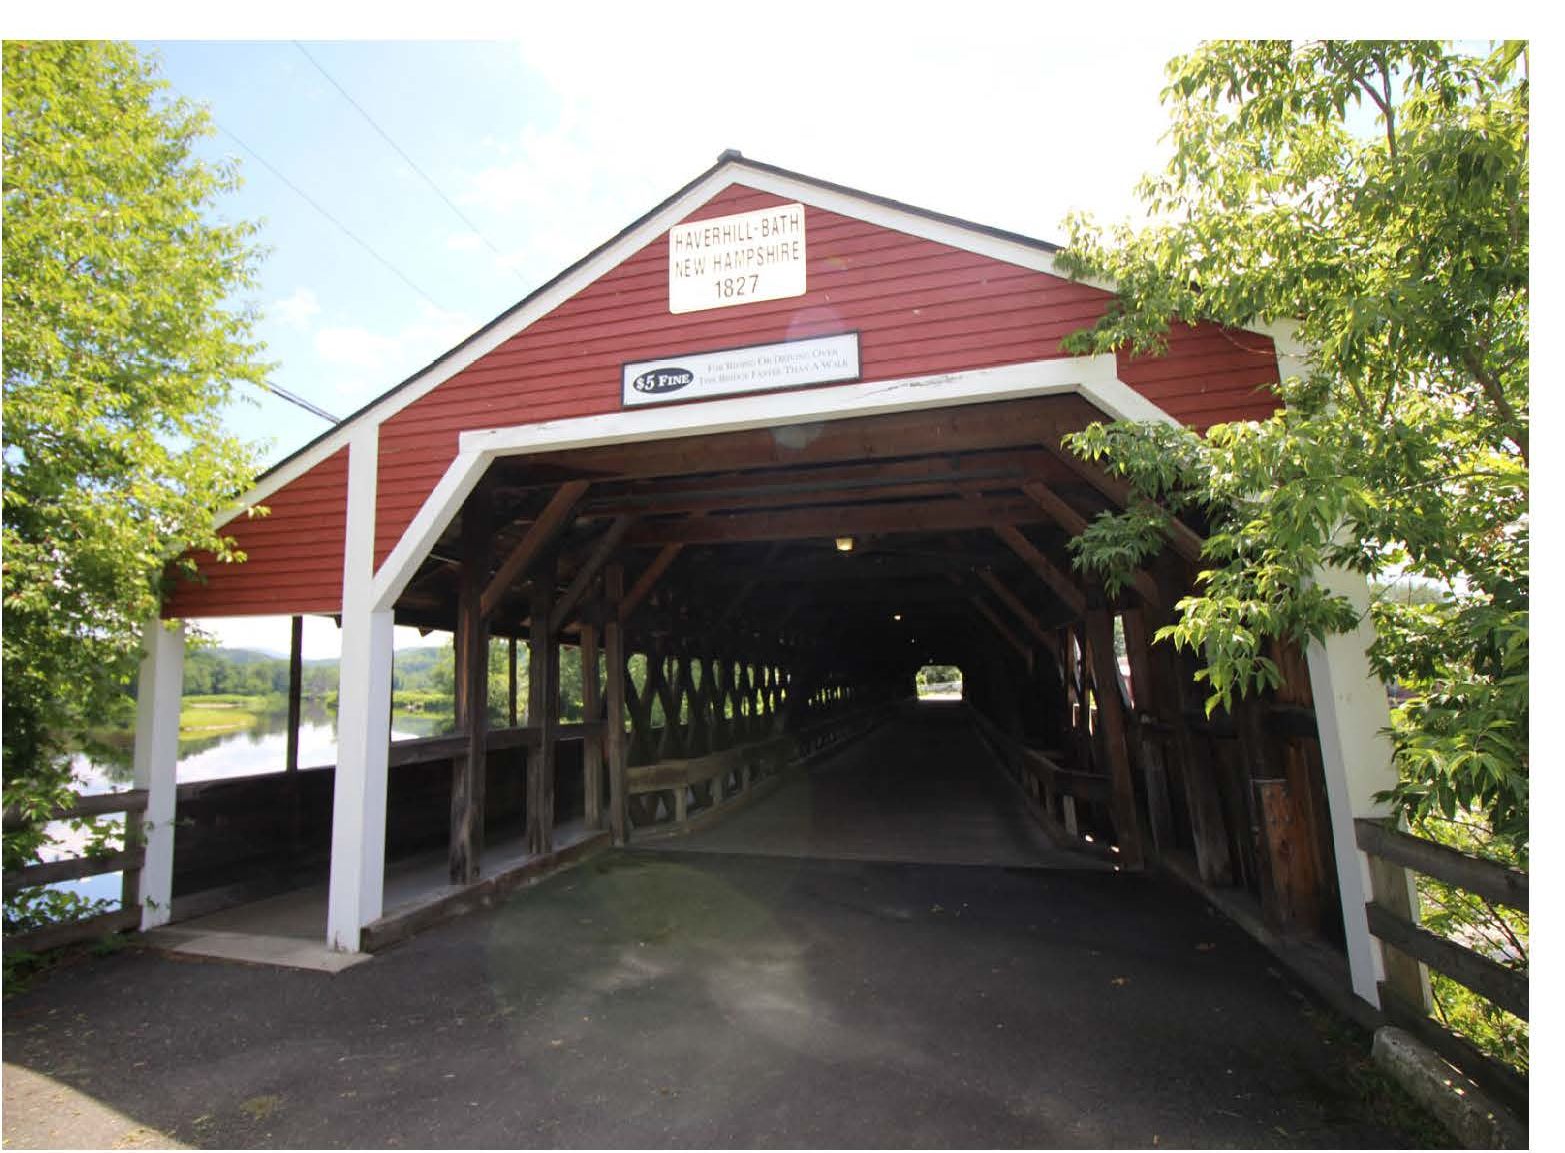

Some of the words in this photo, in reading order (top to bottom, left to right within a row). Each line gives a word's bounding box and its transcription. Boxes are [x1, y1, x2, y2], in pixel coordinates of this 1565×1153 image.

[675, 258, 707, 278] NEW
[713, 241, 800, 271] HAMPSHIRE
[715, 274, 760, 299] 1827
[636, 373, 655, 390] $5
